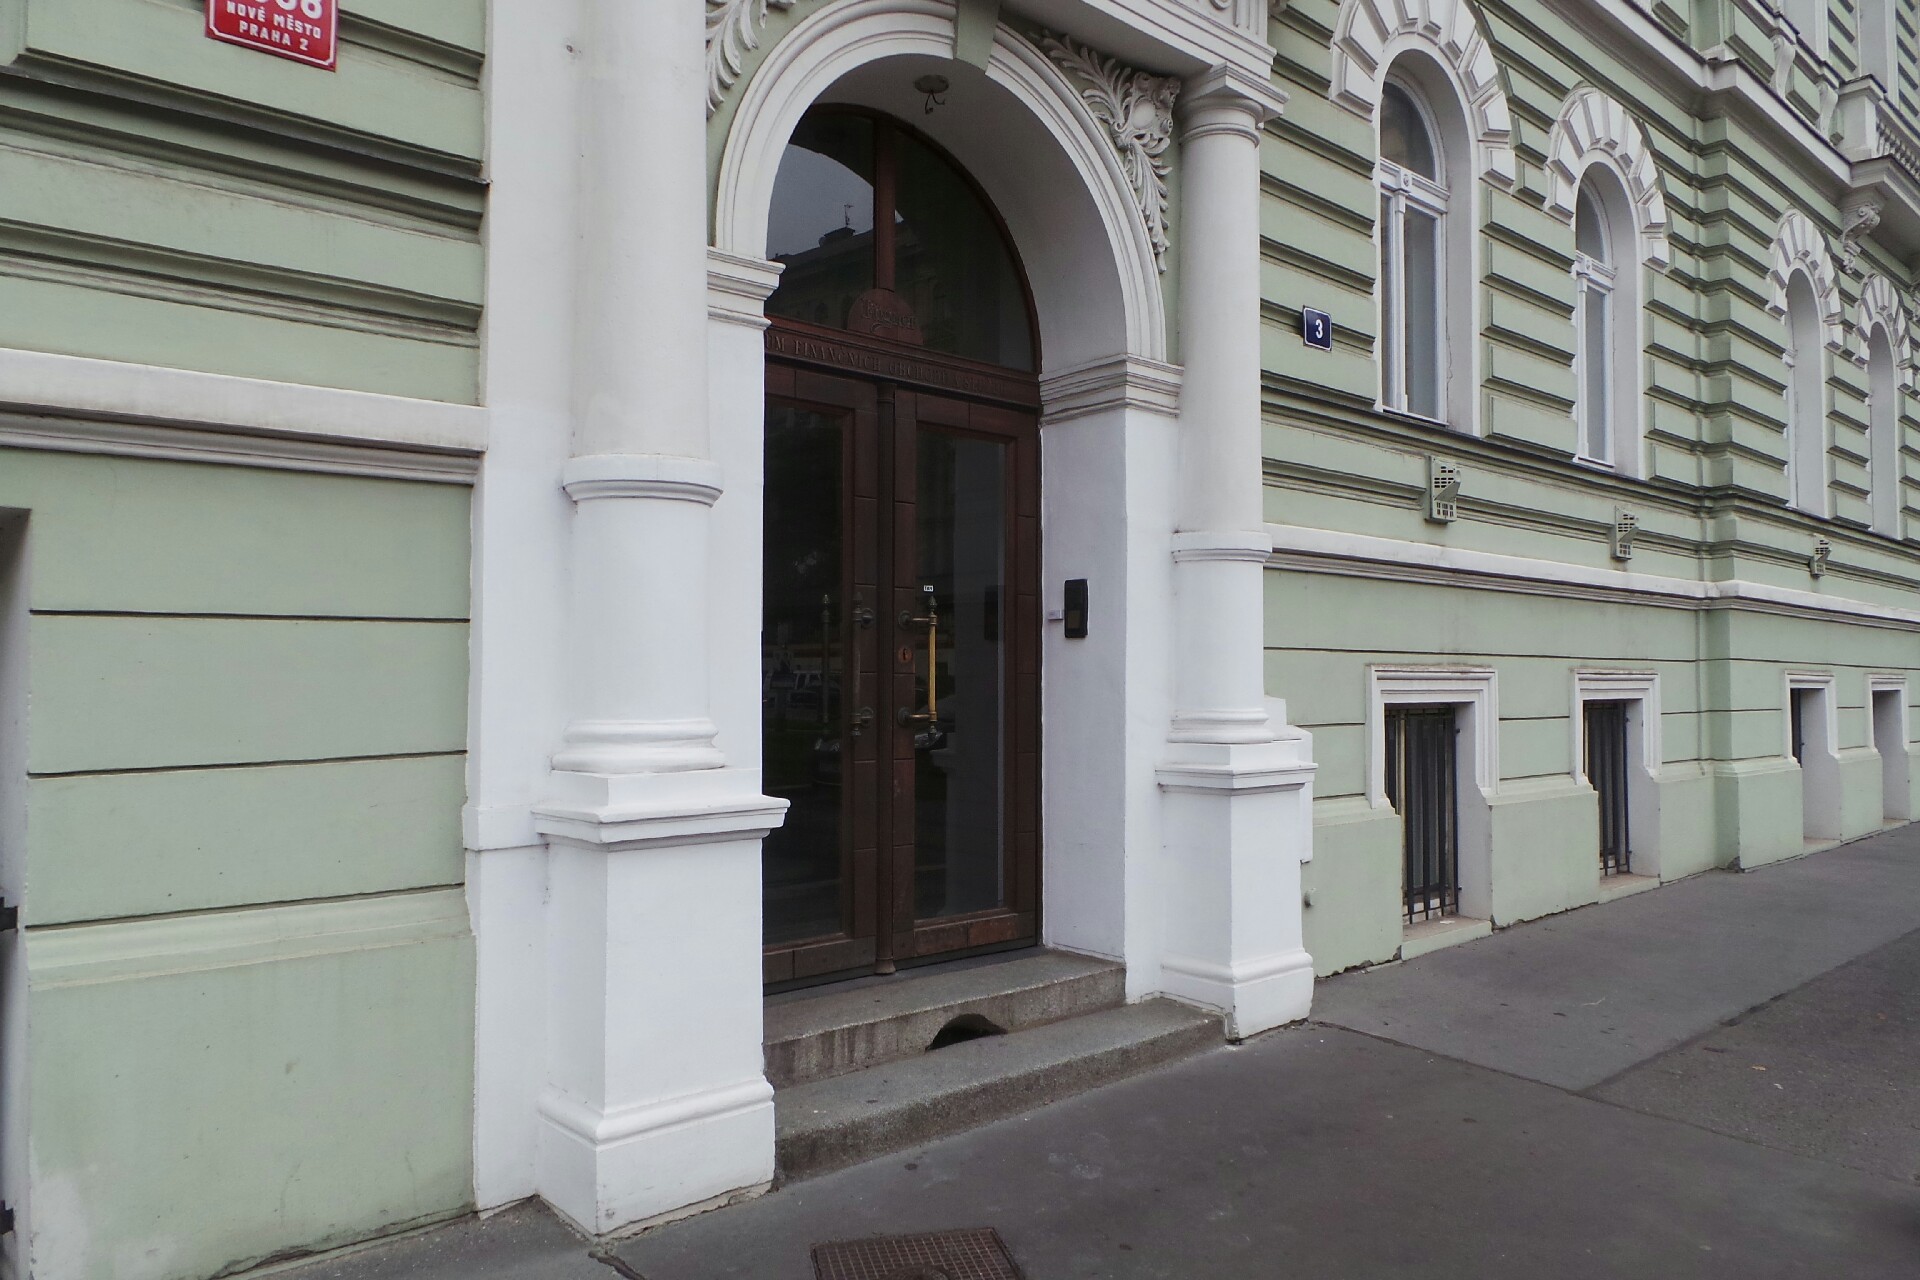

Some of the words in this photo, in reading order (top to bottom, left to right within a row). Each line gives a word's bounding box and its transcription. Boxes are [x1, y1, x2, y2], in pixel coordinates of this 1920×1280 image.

[227, 1, 266, 22] NOVÉ
[273, 14, 321, 39] MĚSTO
[239, 20, 291, 46] PRAHA
[300, 38, 309, 51] 2
[1315, 319, 1324, 339] 3
